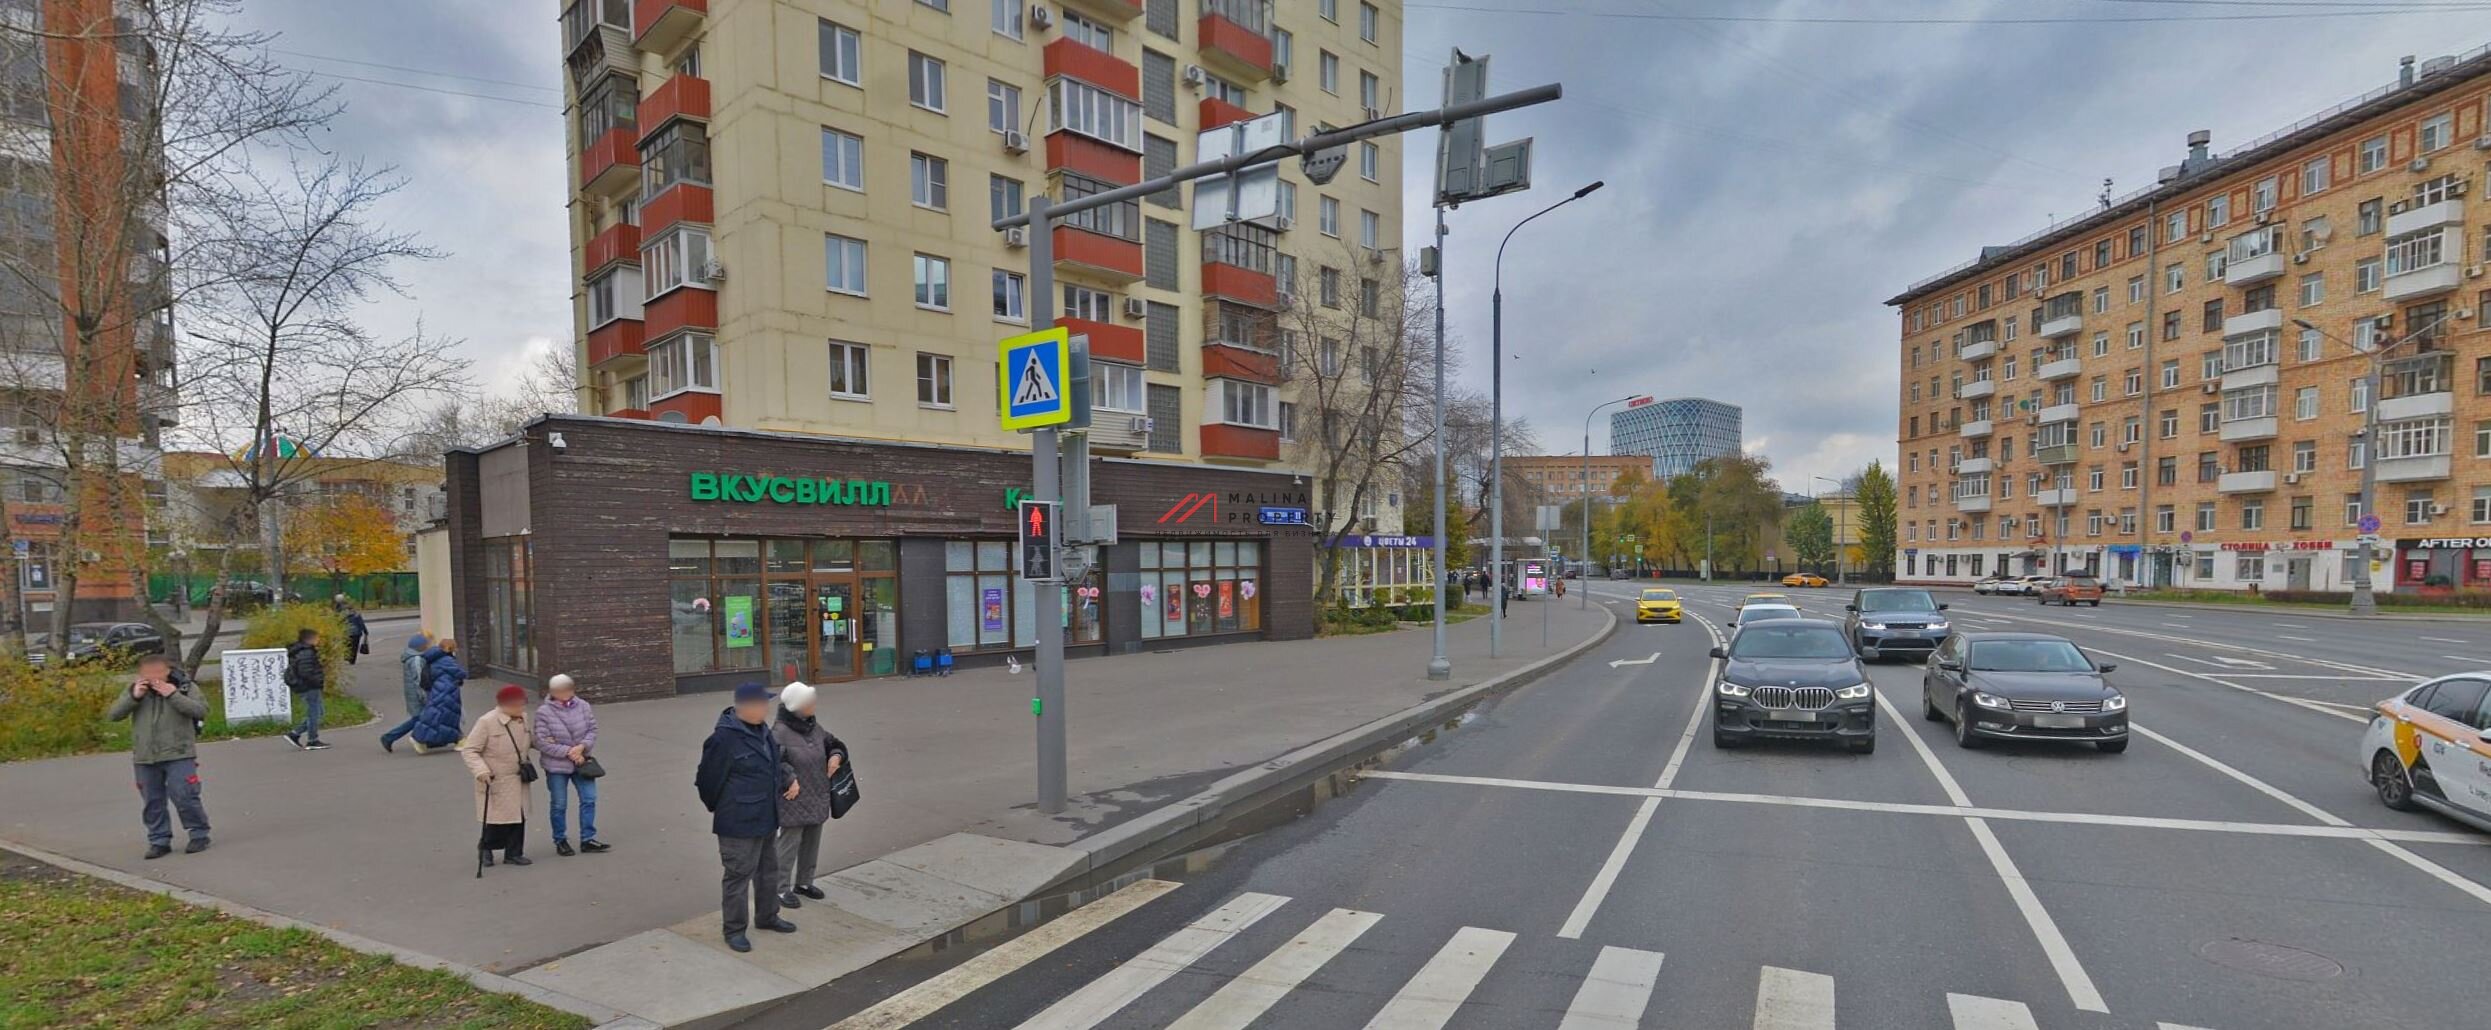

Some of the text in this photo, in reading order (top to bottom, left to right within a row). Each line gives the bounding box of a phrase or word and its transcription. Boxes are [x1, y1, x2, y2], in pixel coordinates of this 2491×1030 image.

[690, 472, 891, 507] ВКУСВИЛЛ
[1378, 536, 1417, 547] ЦВЕТЫ 24
[2220, 541, 2333, 551] СТОЛИЦА ХОББИ
[2417, 538, 2473, 548] AFTER
